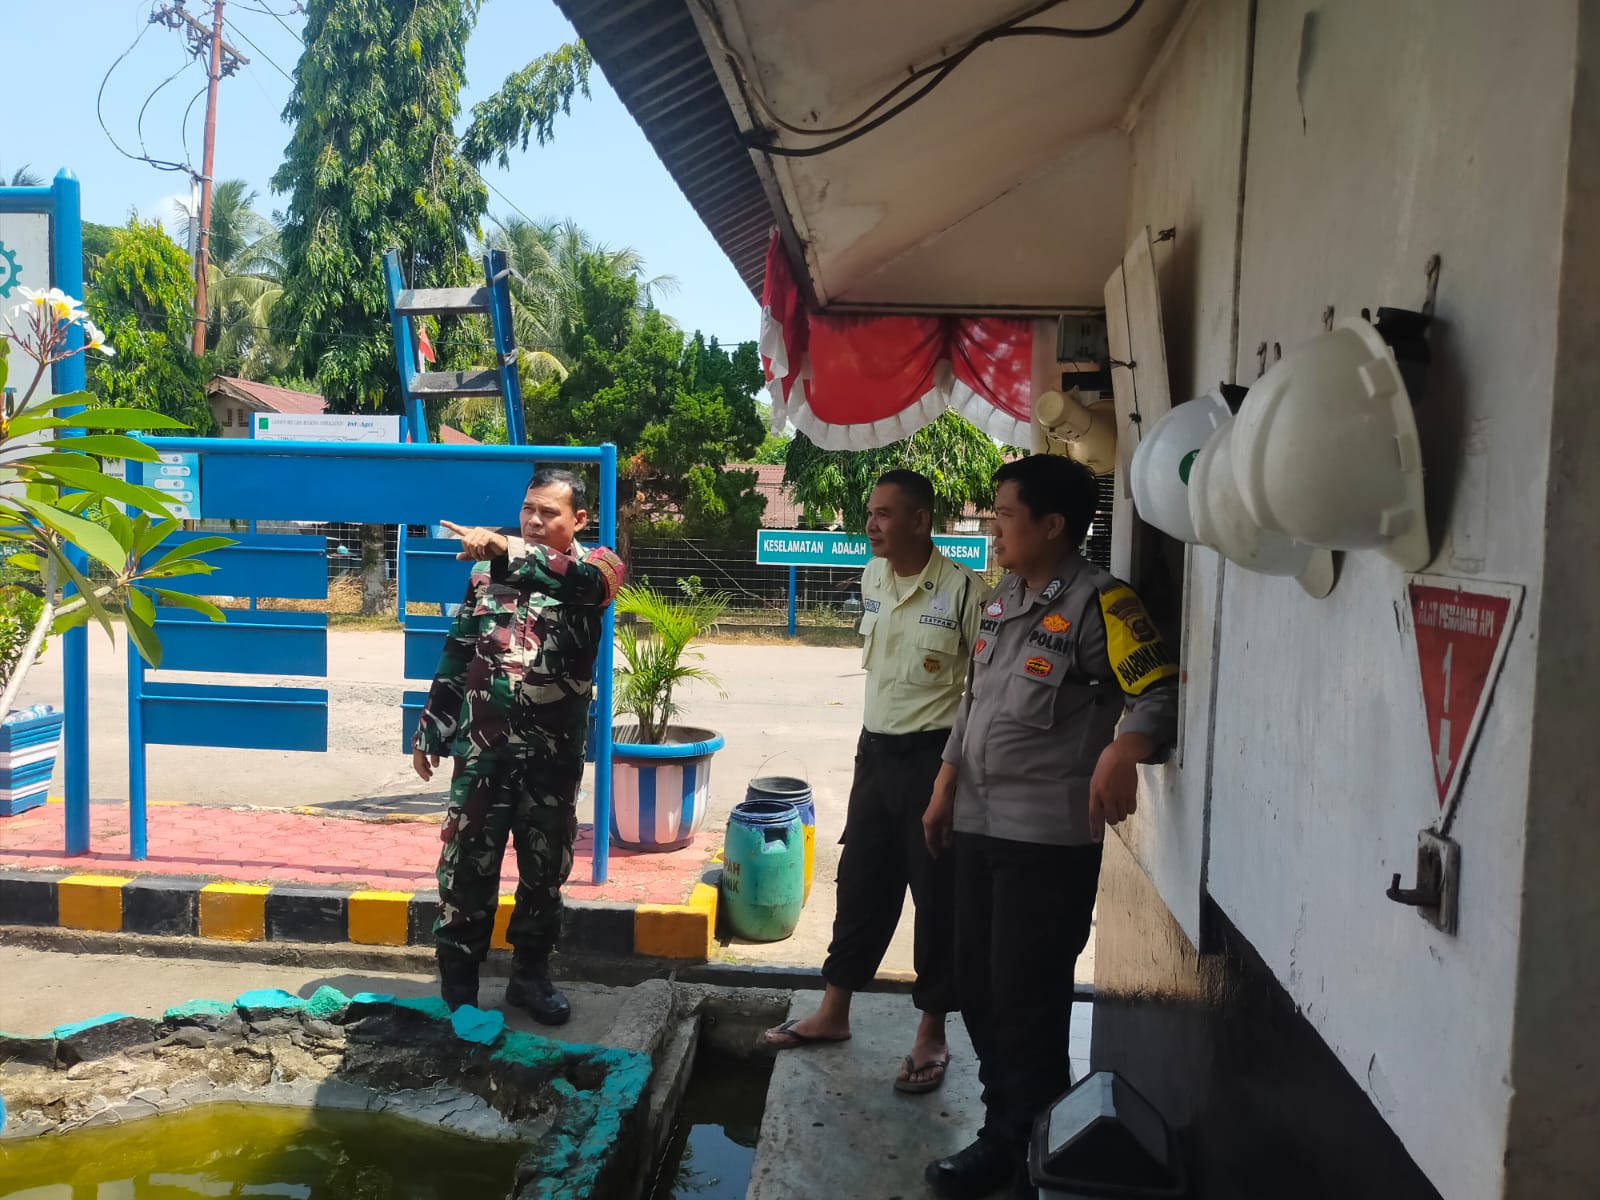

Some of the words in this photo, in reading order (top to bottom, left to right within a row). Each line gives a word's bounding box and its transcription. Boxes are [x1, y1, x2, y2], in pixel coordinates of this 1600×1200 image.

[763, 539, 824, 554] KESELAMATAN
[831, 541, 867, 555] ADALAH
[938, 545, 980, 558] UKSESAN
[1478, 608, 1495, 639] API
[1029, 630, 1069, 654] POLRI
[1116, 642, 1166, 687] BHABINKA
